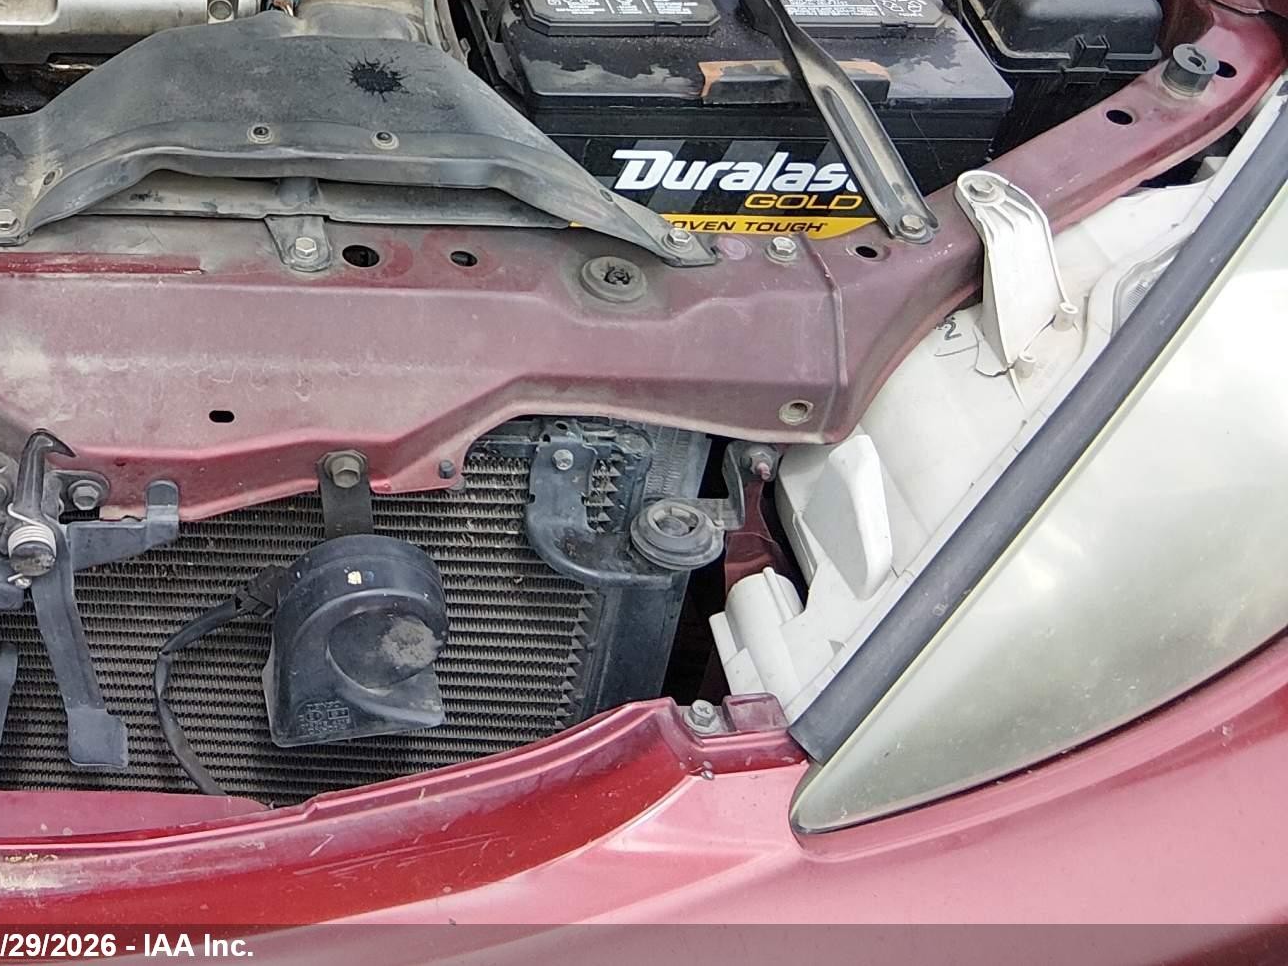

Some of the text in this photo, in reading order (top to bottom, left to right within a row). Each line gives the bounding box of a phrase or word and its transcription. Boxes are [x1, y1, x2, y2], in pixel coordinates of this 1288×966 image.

[612, 149, 857, 192] Duralas
[744, 194, 863, 210] GOLD
[668, 221, 823, 232] OVEN TOUGH
